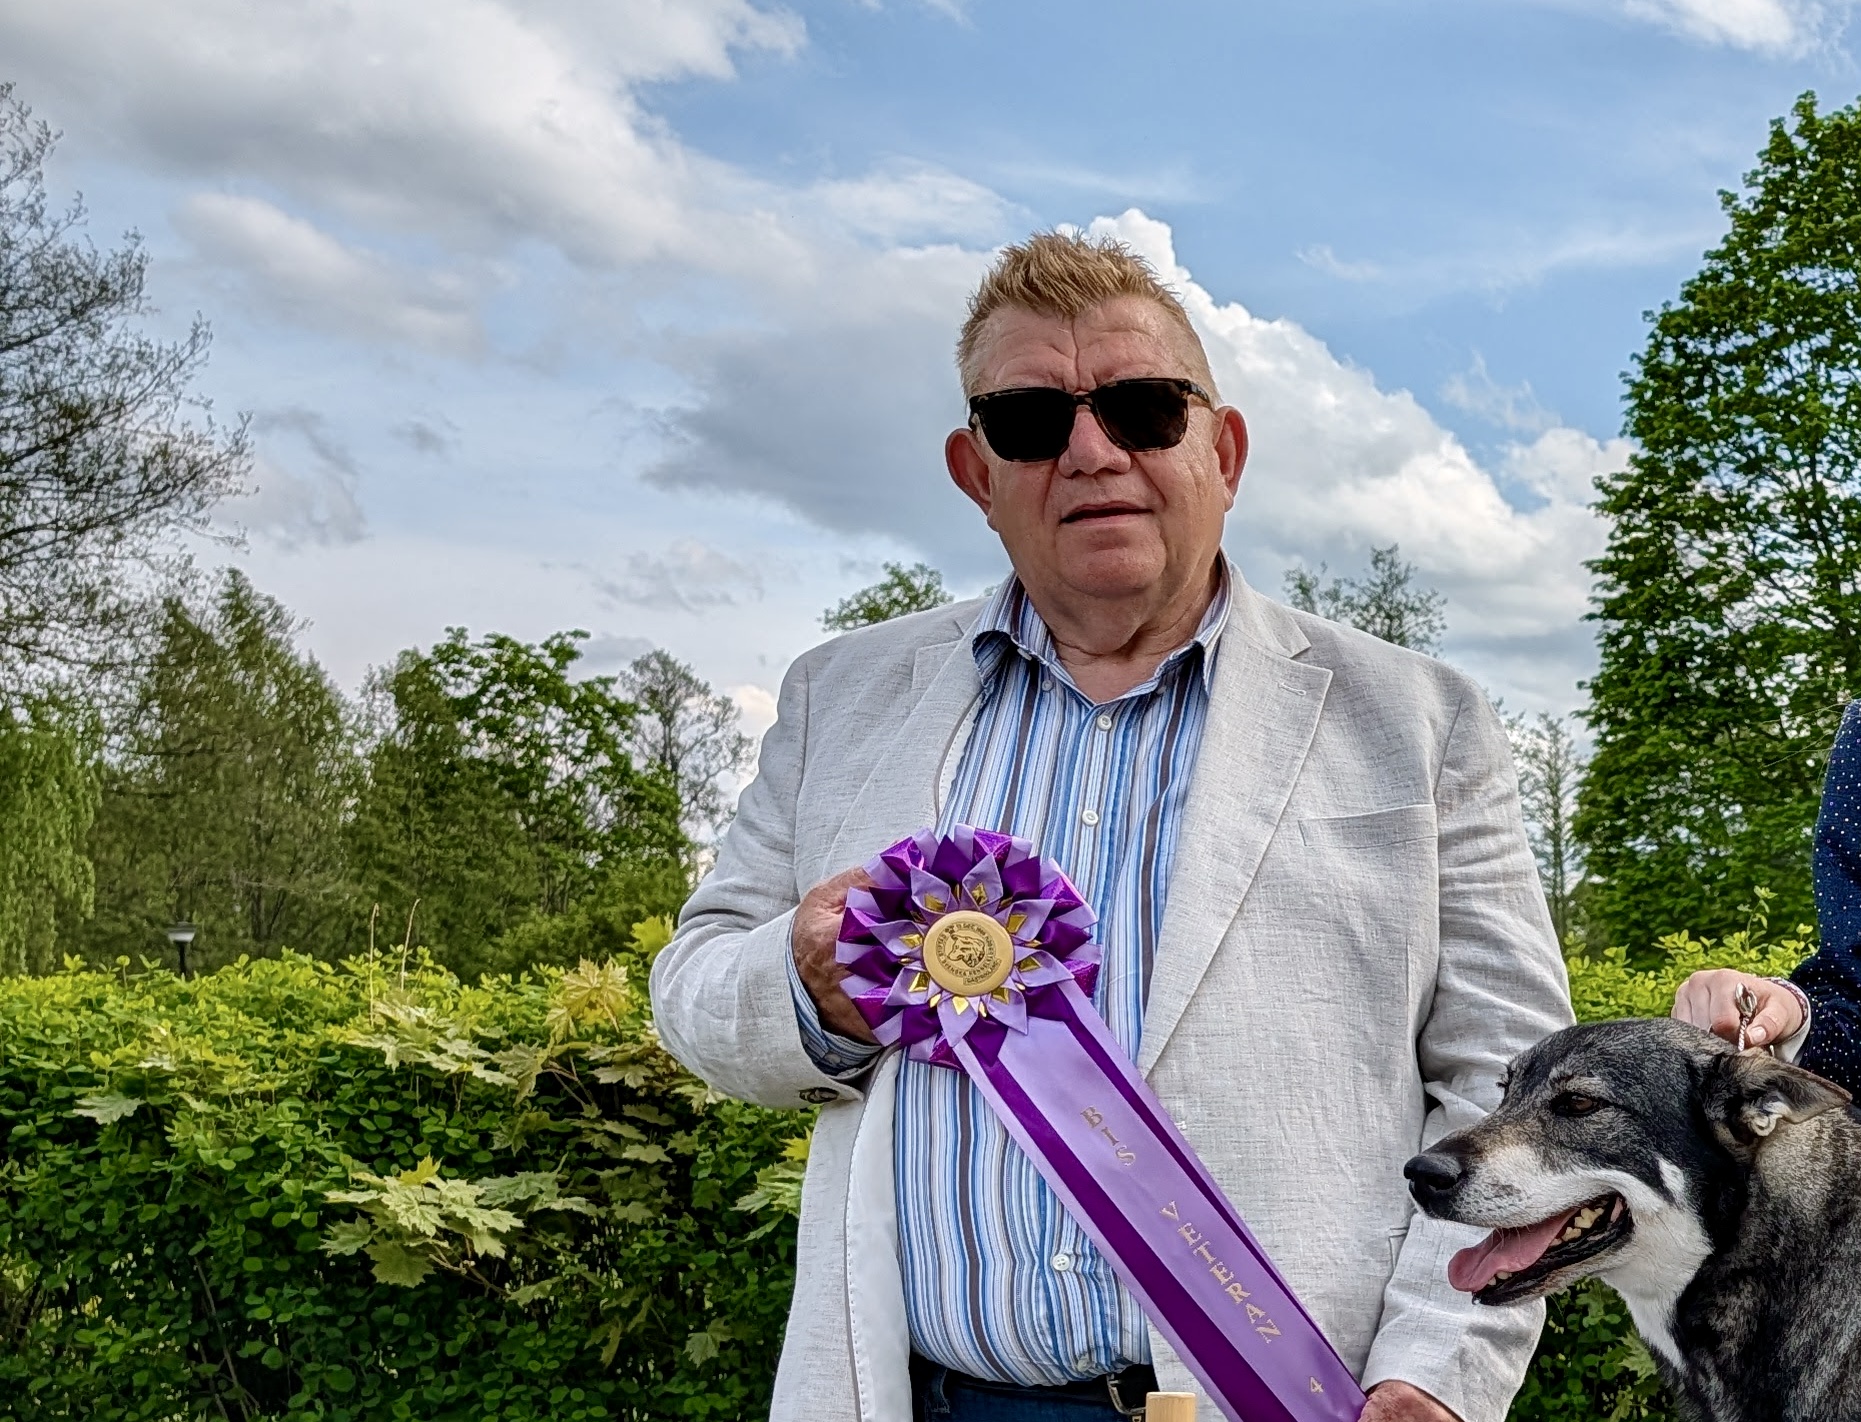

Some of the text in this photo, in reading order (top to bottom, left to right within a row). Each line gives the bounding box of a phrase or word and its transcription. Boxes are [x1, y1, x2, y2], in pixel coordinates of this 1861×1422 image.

[1080, 1106, 1324, 1395] BIS VETERAN 4
